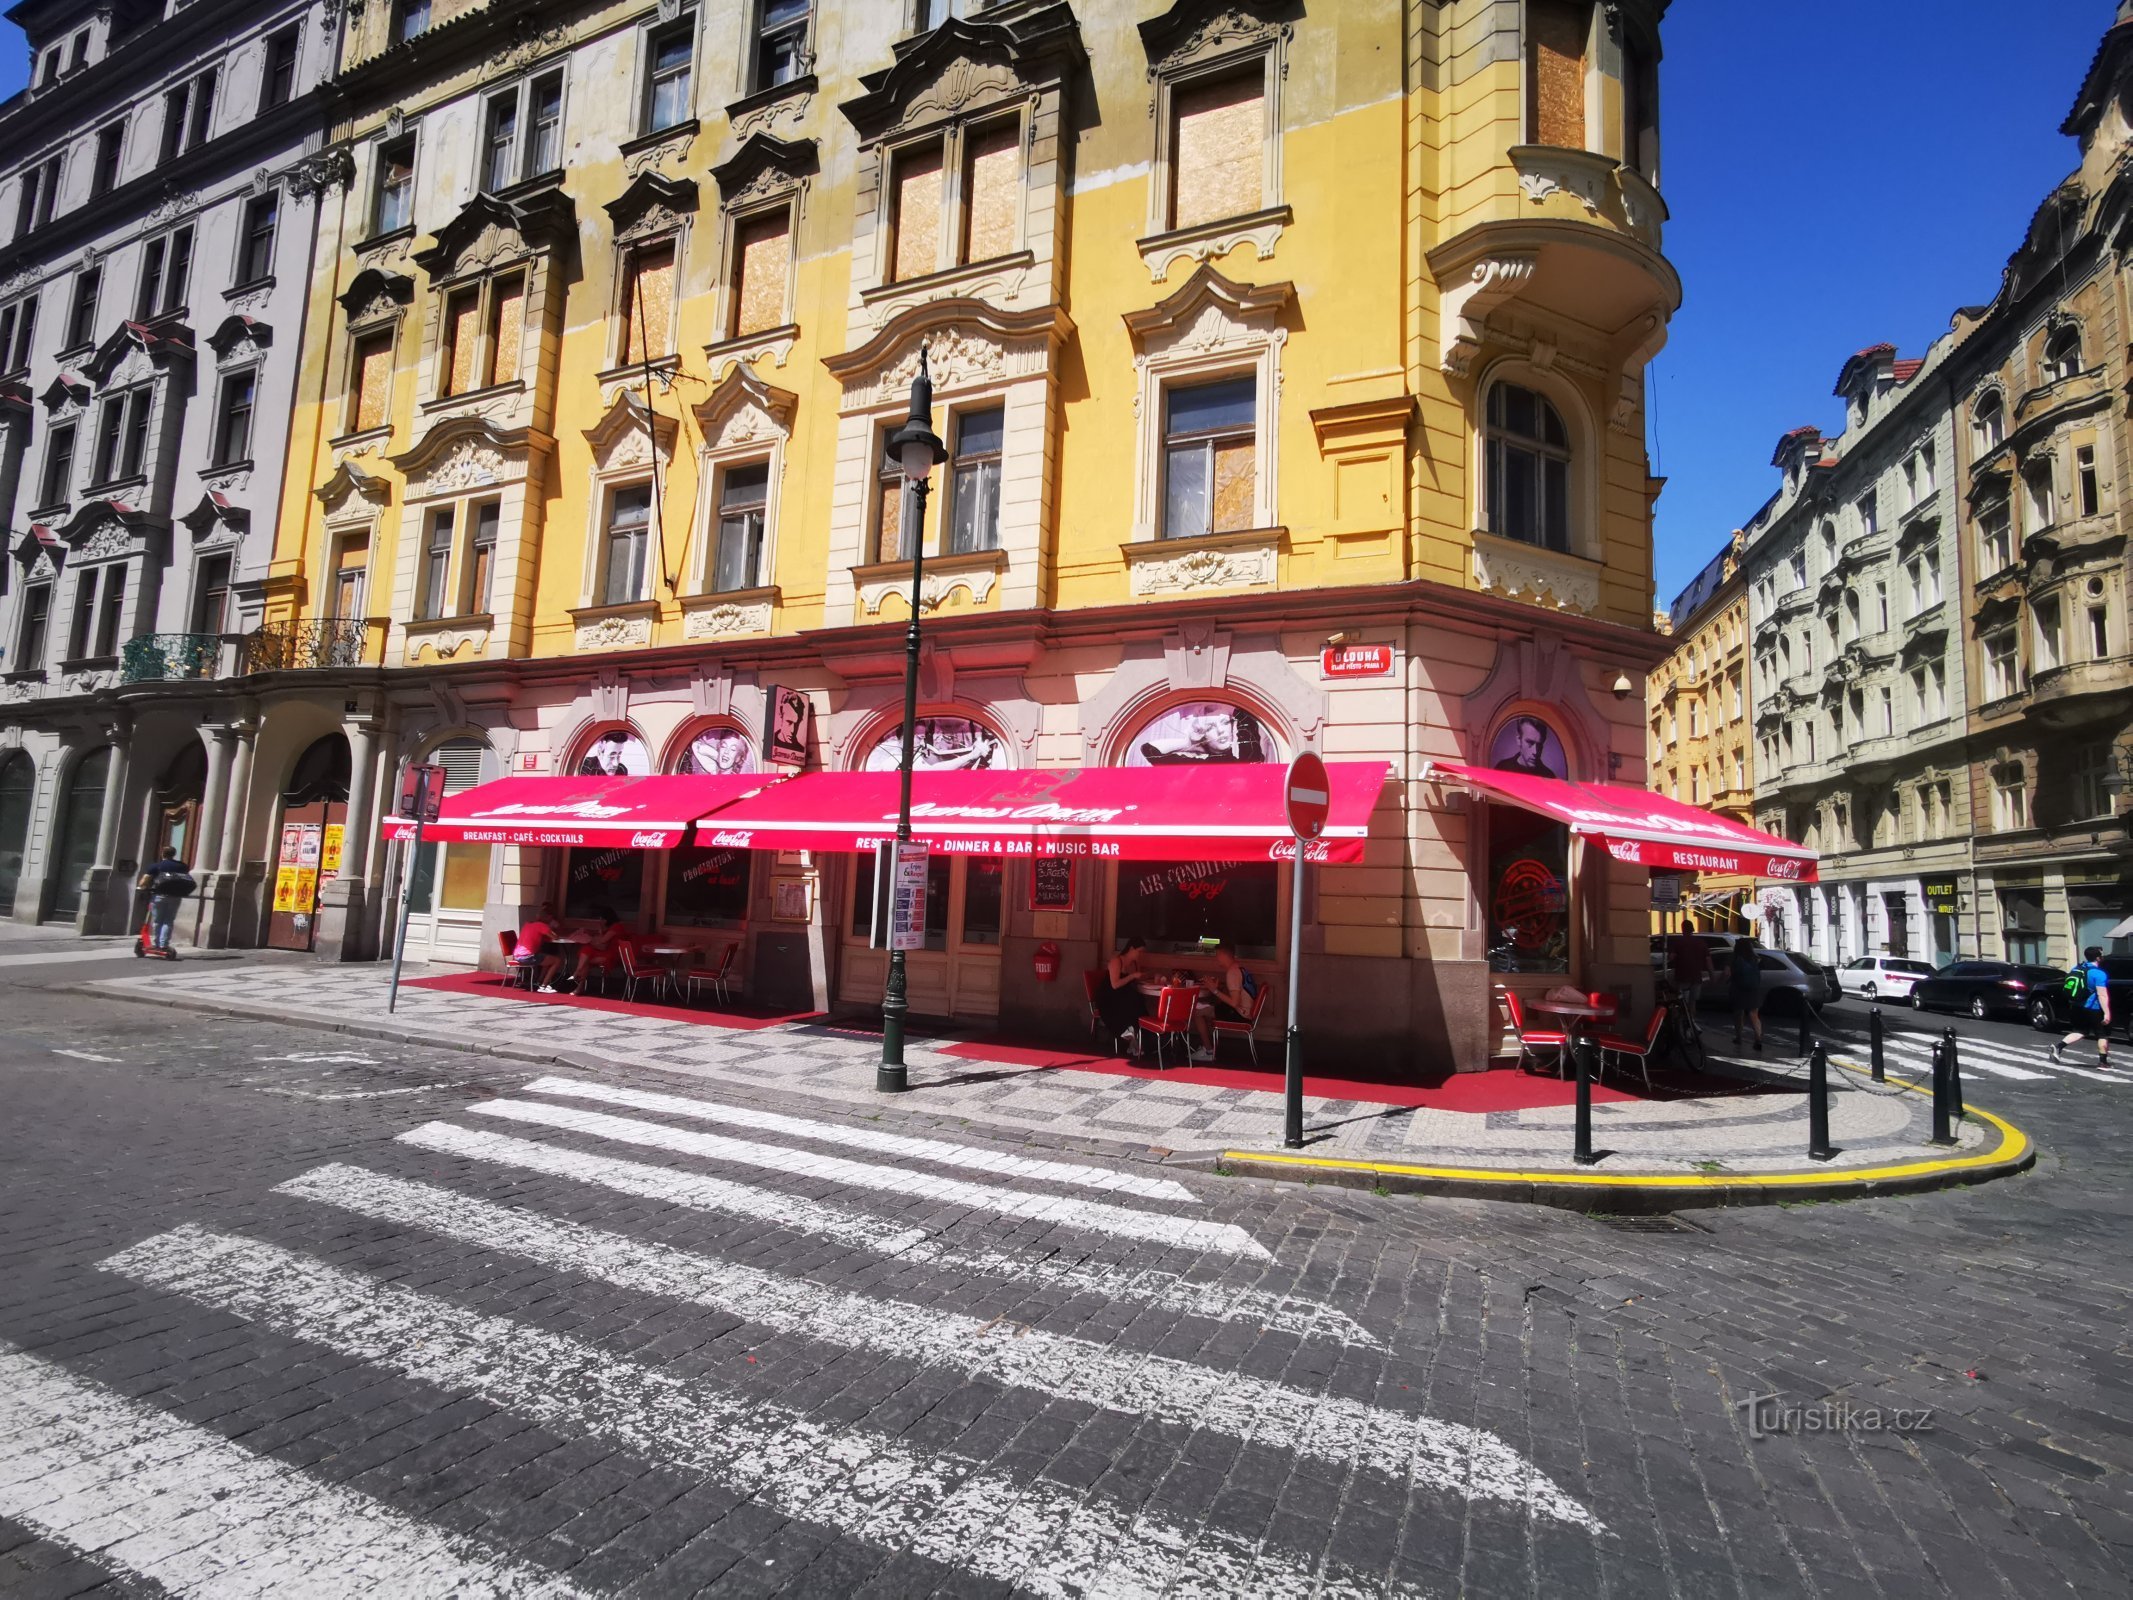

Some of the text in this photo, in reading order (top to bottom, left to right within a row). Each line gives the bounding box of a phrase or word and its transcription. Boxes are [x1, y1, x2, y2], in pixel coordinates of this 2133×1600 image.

[1335, 648, 1380, 663] DLOUHÁ
[463, 830, 584, 844] BREAKFAST CAFÉ COCKTAILS
[631, 831, 667, 848] Coca-Cola
[711, 830, 754, 848] Coca-Cola
[943, 841, 990, 853] DINNER
[994, 841, 1002, 852] &
[1007, 841, 1033, 853] BAR
[1045, 842, 1087, 855] MUSIC
[1091, 843, 1120, 855] BAR
[1606, 839, 1641, 862] oca-Cola
[1673, 851, 1739, 870] RESTAURANT
[1767, 857, 1802, 879] Coca-Cola
[1140, 873, 1164, 896] AIR
[1926, 884, 1953, 896] OUTLET
